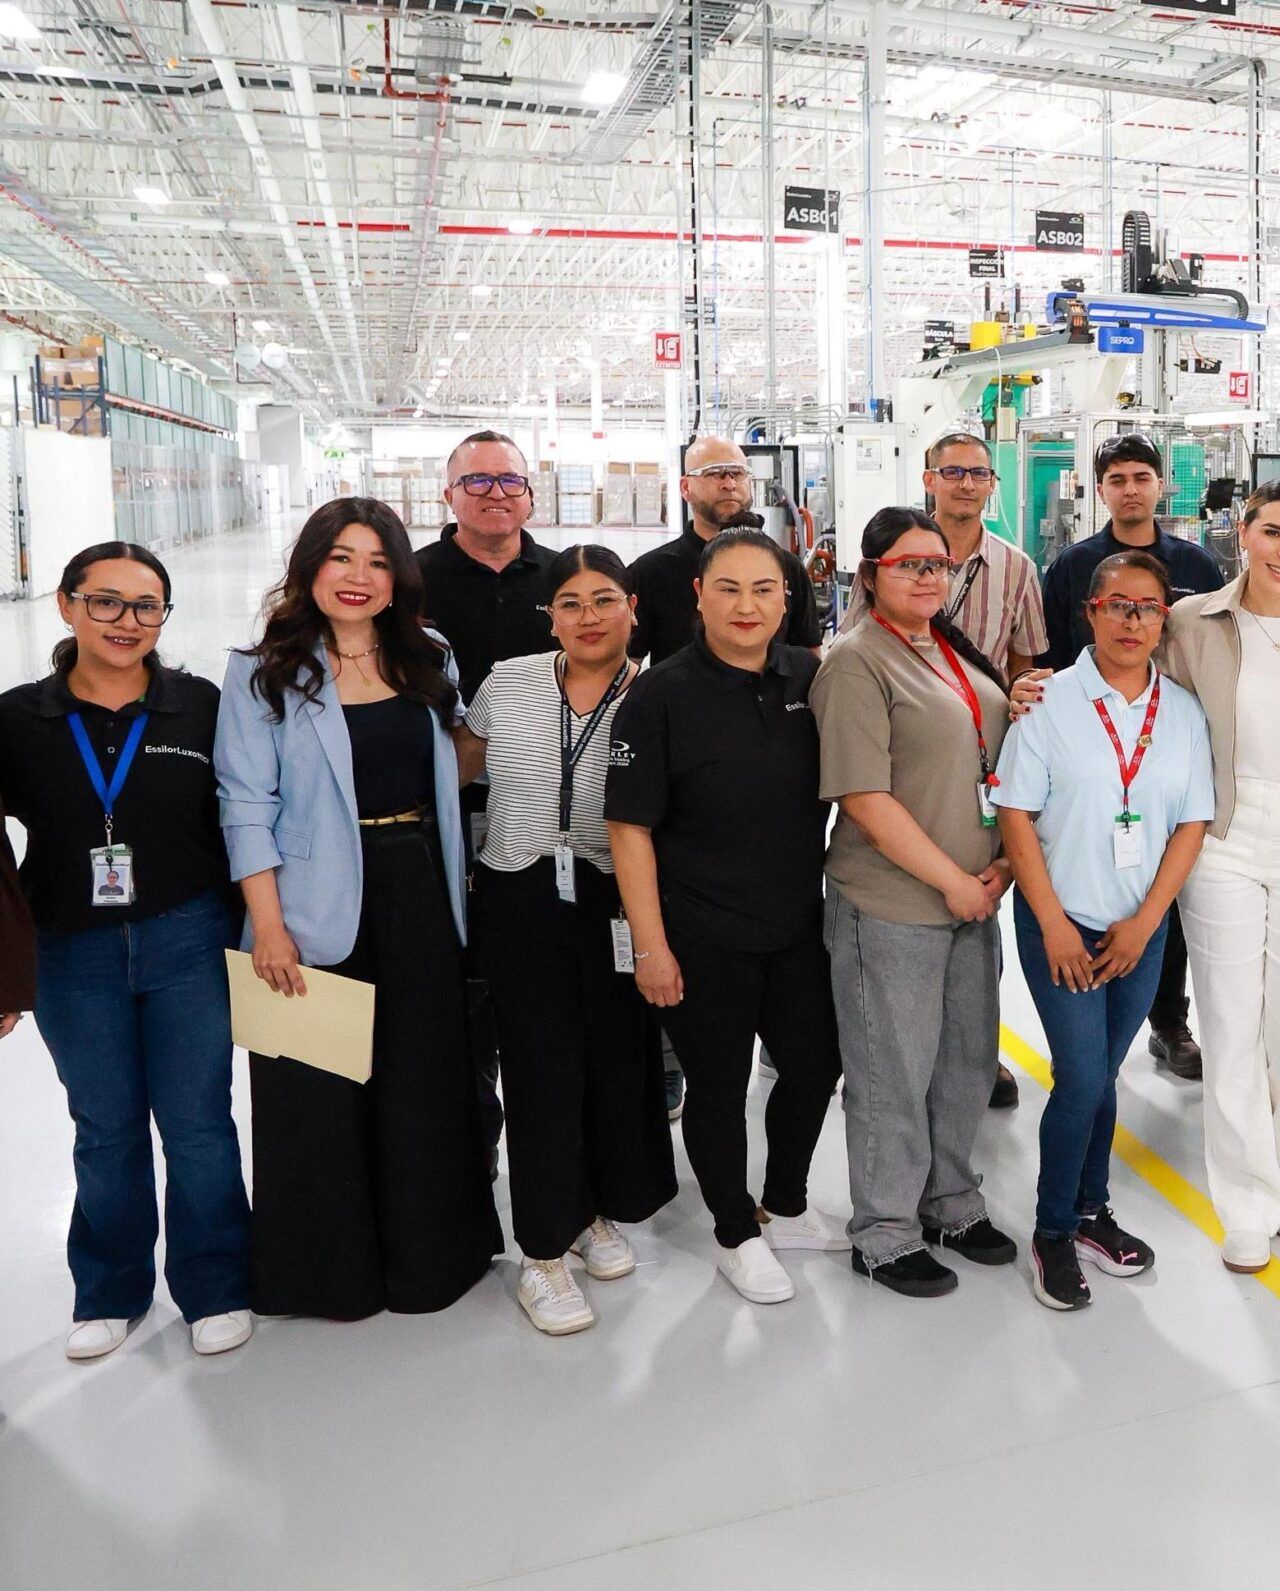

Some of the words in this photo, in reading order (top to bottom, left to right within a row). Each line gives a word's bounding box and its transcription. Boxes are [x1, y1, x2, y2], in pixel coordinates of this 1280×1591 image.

[786, 206, 837, 225] ASB01
[1037, 230, 1083, 246] ASB02
[1110, 336, 1134, 344] SEPRO
